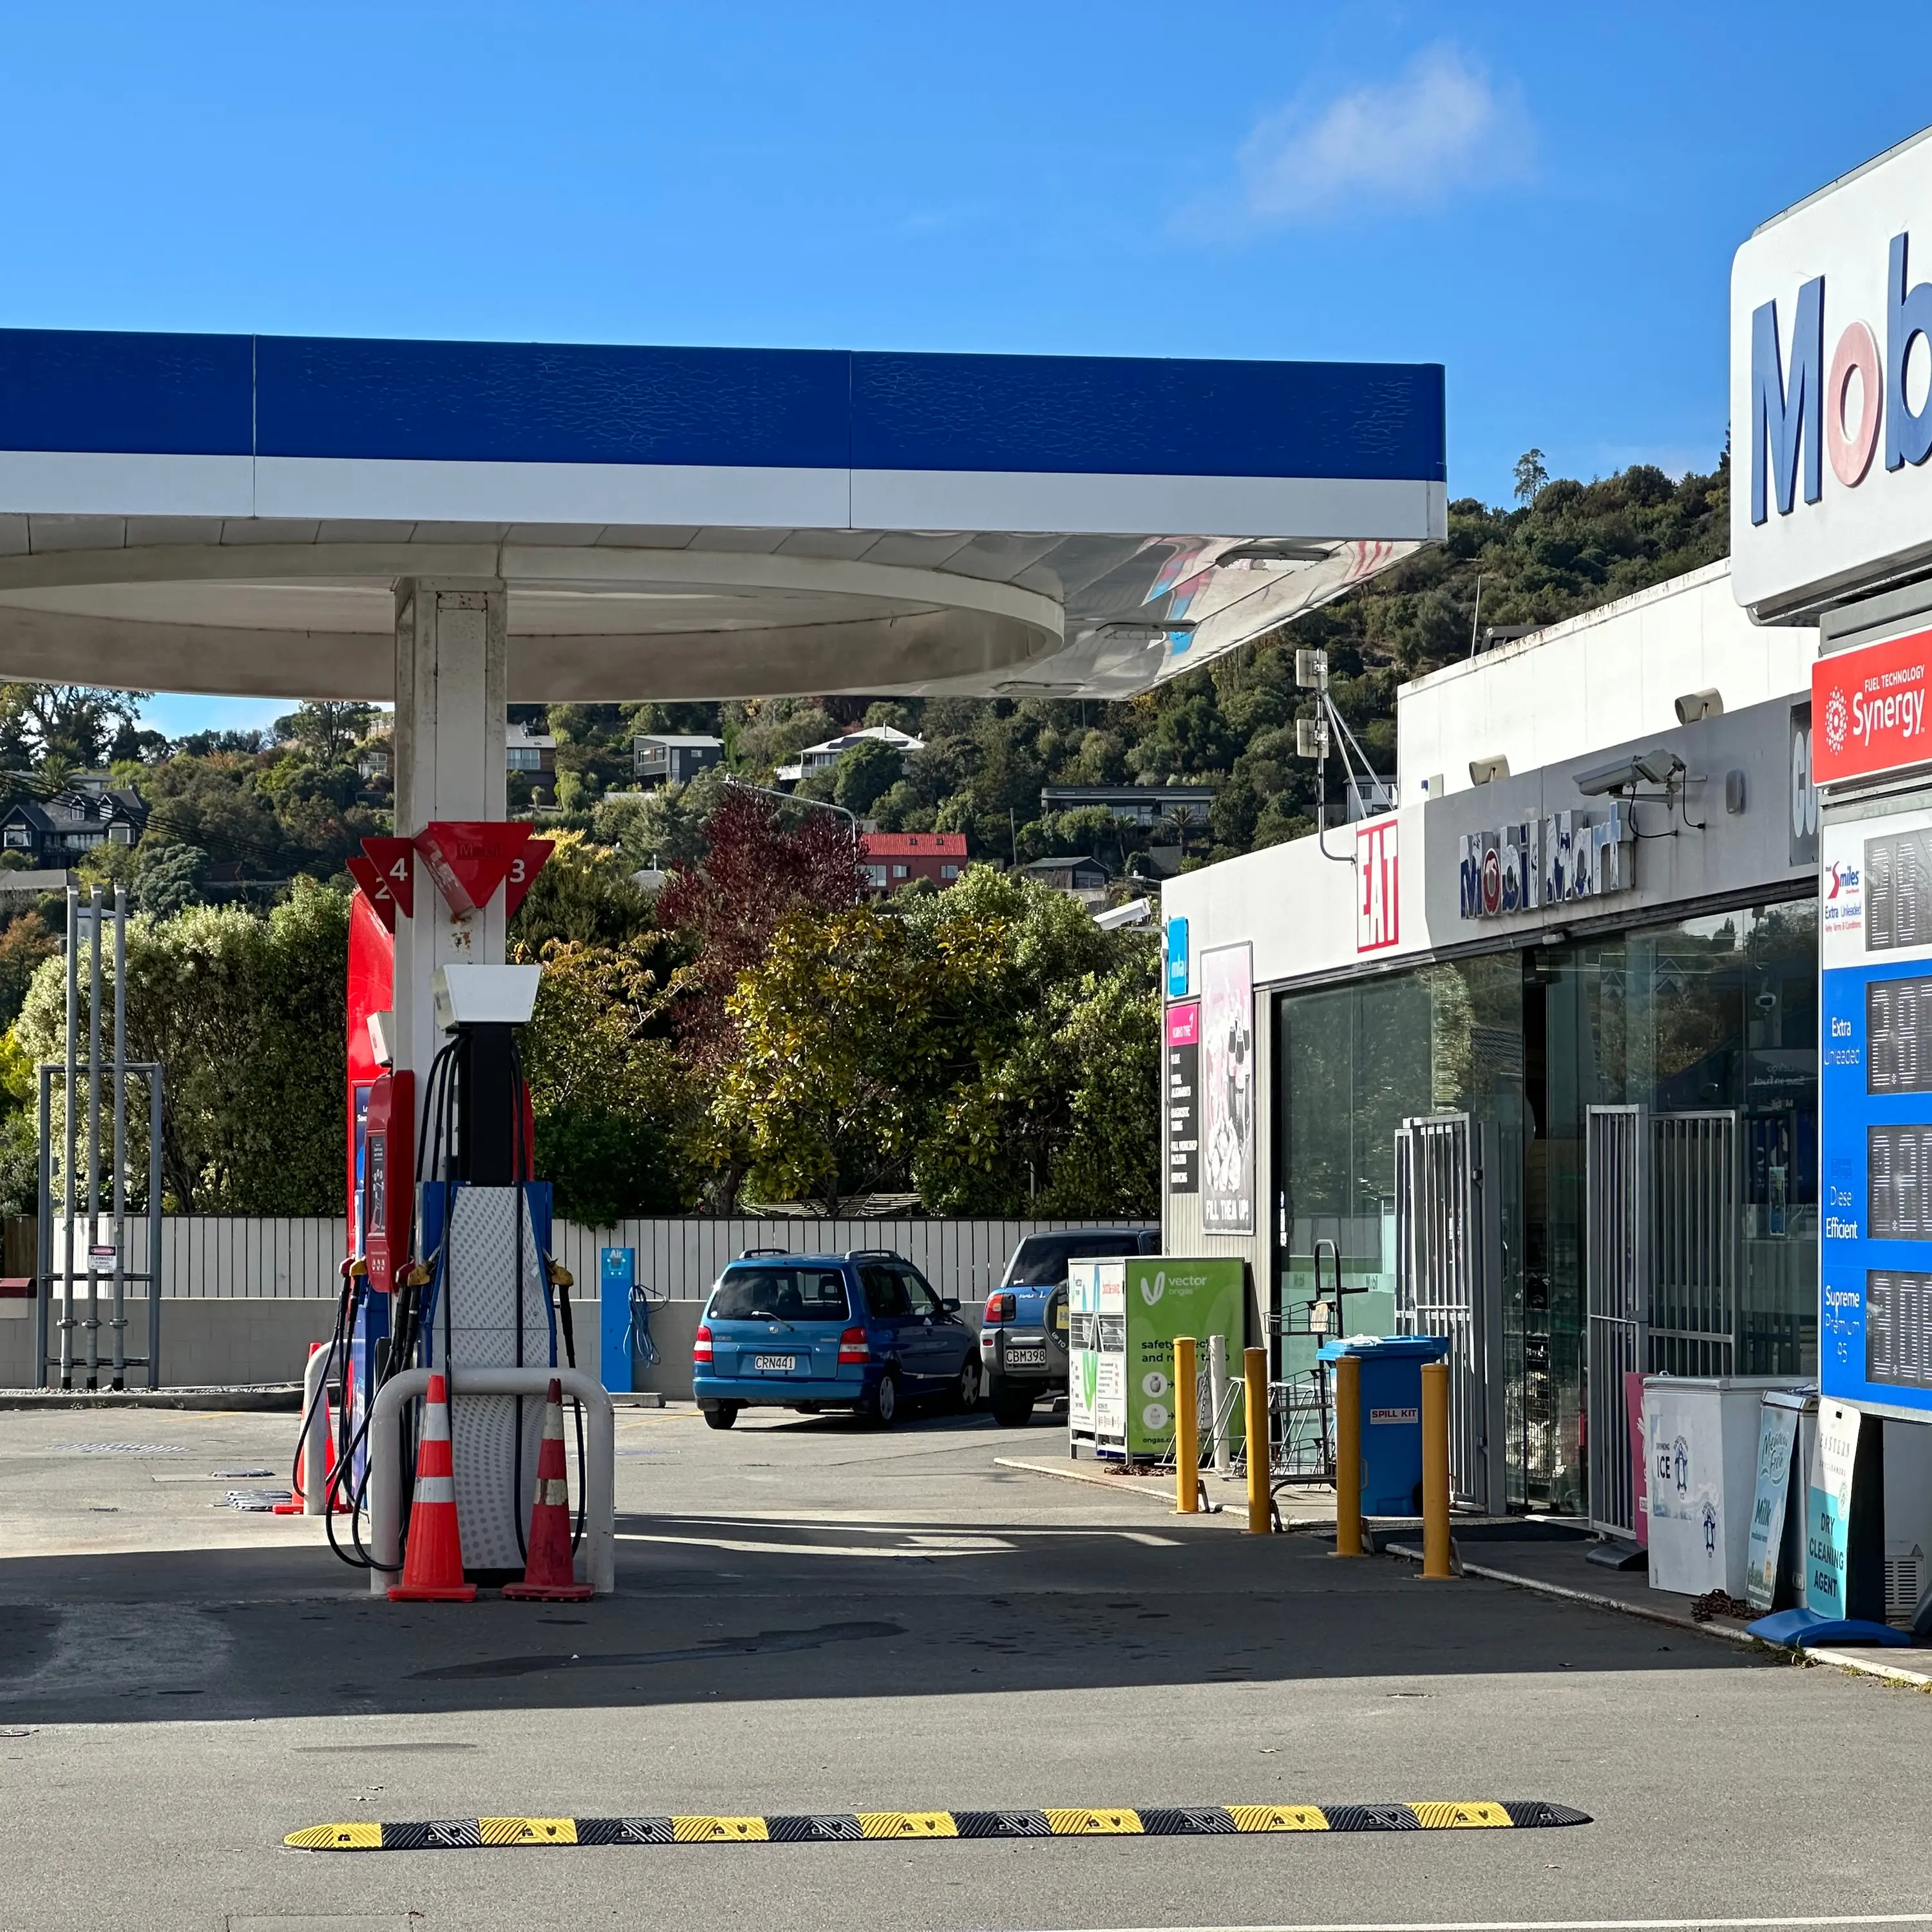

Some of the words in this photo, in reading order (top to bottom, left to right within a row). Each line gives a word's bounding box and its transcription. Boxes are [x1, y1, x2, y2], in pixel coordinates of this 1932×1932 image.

[1864, 677, 1880, 693] FUEL
[1881, 664, 1925, 688] TECHNOLOGY
[1853, 688, 1925, 746] Synergy
[389, 857, 408, 882] 4
[509, 859, 526, 883] 3
[1459, 819, 1544, 920] Mobil
[1545, 801, 1623, 904] Mart
[375, 878, 390, 899] 2
[1357, 823, 1398, 949] EAT
[1828, 860, 1860, 899] Smiles
[1825, 905, 1839, 920] Extra
[1832, 1017, 1852, 1037] Extra
[1830, 1186, 1852, 1206] Diese
[1206, 1199, 1219, 1220] FILL
[1238, 1198, 1249, 1220] UP!
[1826, 1217, 1858, 1240] Efficient
[611, 1249, 623, 1258] Air
[1168, 1275, 1208, 1286] vector
[1826, 1285, 1860, 1317] Supreme
[1058, 1340, 1066, 1349] TO
[1141, 1340, 1174, 1350] safety
[755, 1356, 793, 1369] CRN441
[1006, 1350, 1046, 1363] CBM398
[1142, 1353, 1163, 1362] and
[1372, 1410, 1398, 1418] SPILL
[1401, 1409, 1417, 1417] KIT
[1656, 1455, 1671, 1479] ICE
[1754, 1497, 1772, 1528] Milk
[1821, 1511, 1835, 1536] DRY
[1809, 1537, 1844, 1571] CLEANING
[1814, 1569, 1838, 1598] AGENT
